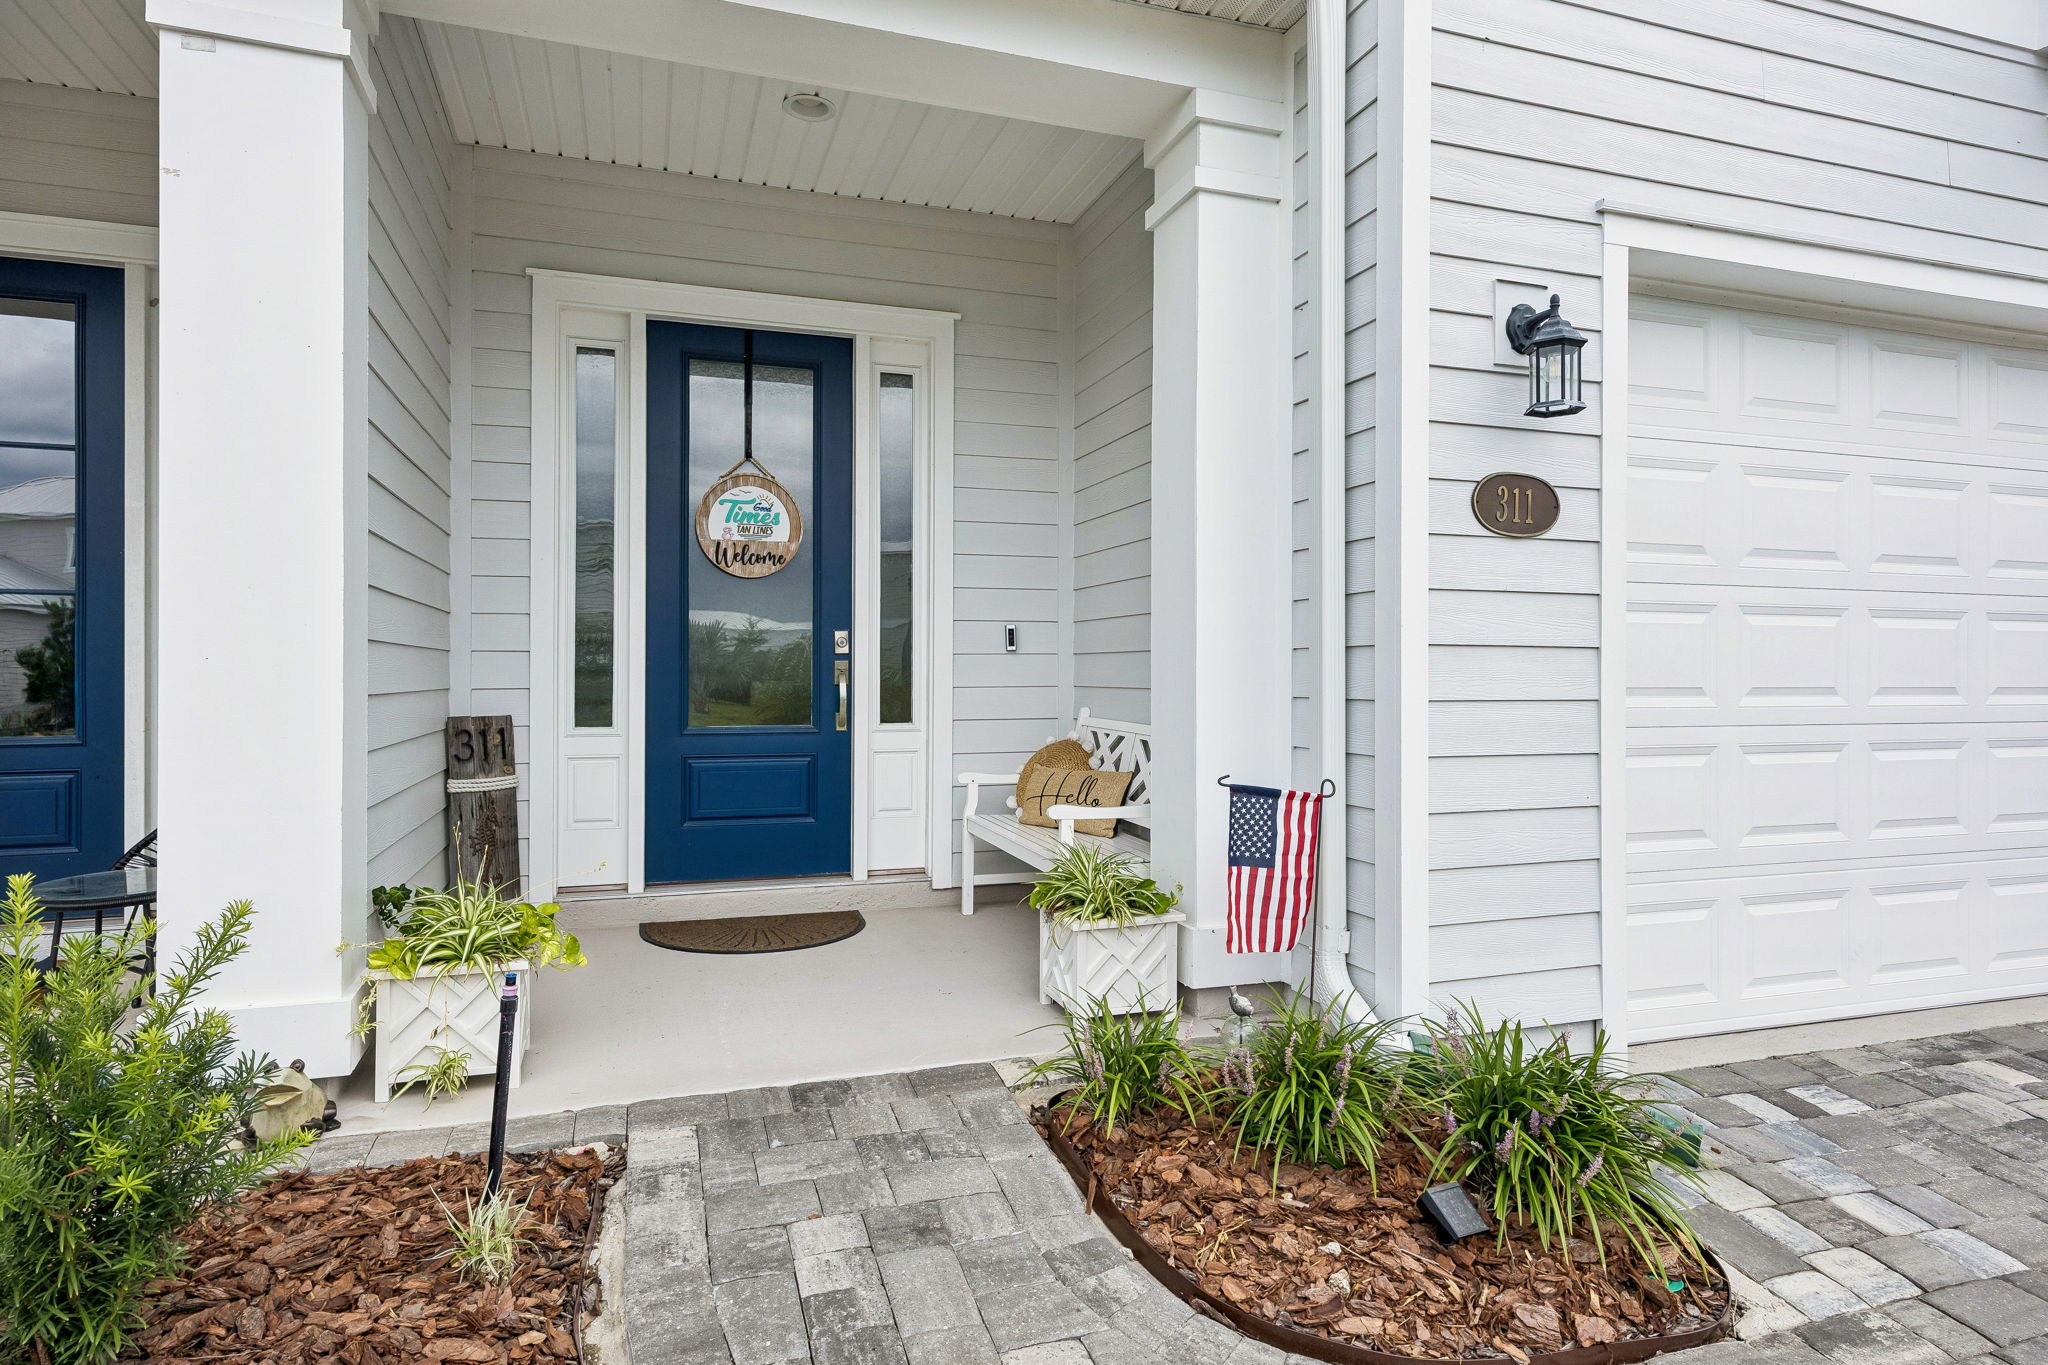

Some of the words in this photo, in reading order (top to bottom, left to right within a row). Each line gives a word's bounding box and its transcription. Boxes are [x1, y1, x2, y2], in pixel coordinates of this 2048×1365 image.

[718, 497, 781, 526] Times
[752, 502, 774, 513] Good
[1496, 485, 1533, 524] 311
[736, 525, 752, 535] TAN
[752, 525, 774, 536] LINES
[714, 541, 787, 568] Welcome
[453, 727, 507, 763] 311
[1026, 770, 1103, 818] Hello
